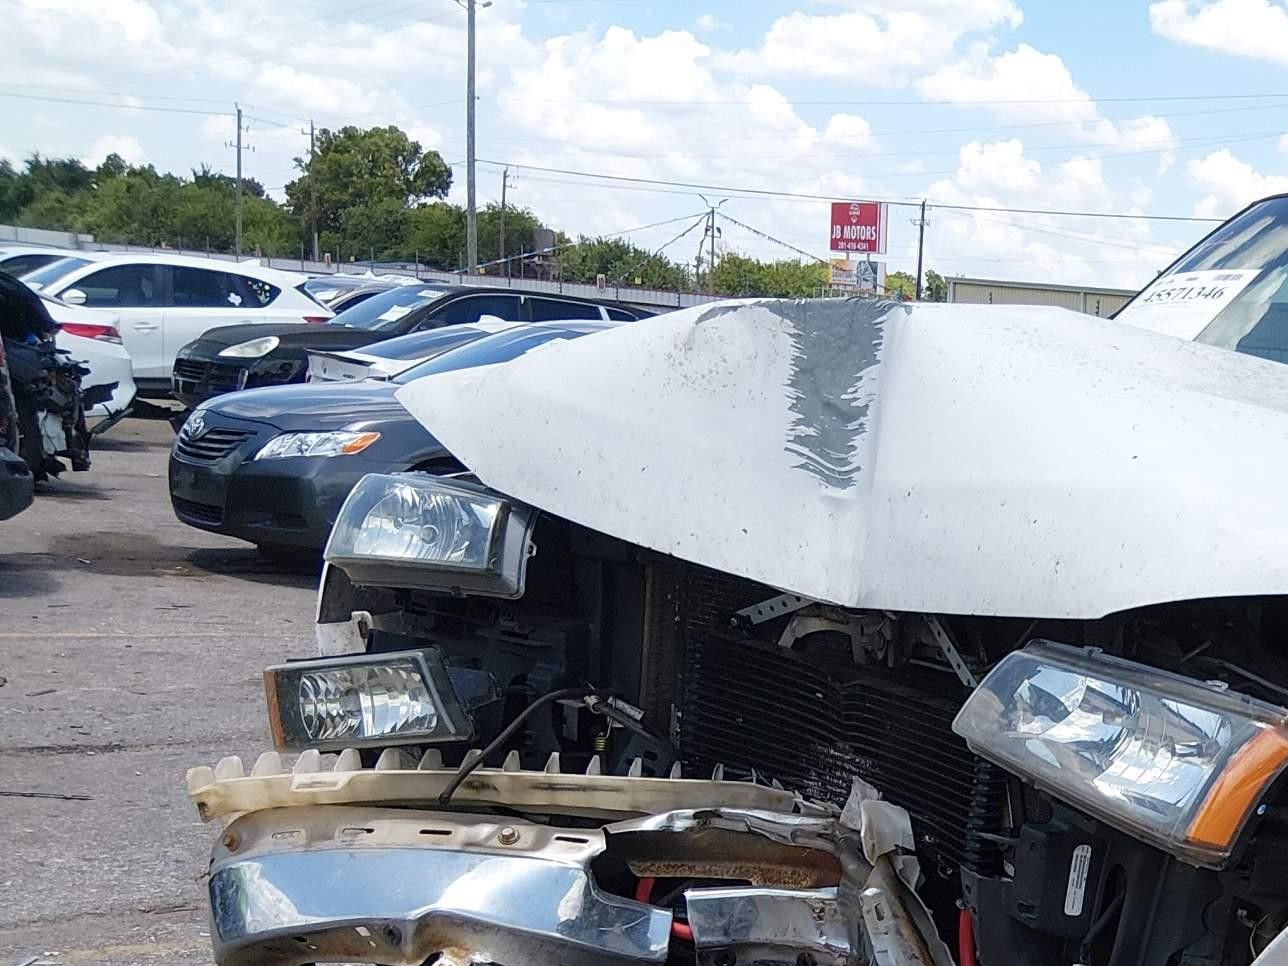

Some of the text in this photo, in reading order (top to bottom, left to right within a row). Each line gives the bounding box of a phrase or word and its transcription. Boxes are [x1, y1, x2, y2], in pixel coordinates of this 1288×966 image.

[832, 225, 876, 241] JB MOTORS
[1143, 285, 1229, 303] 45571346
